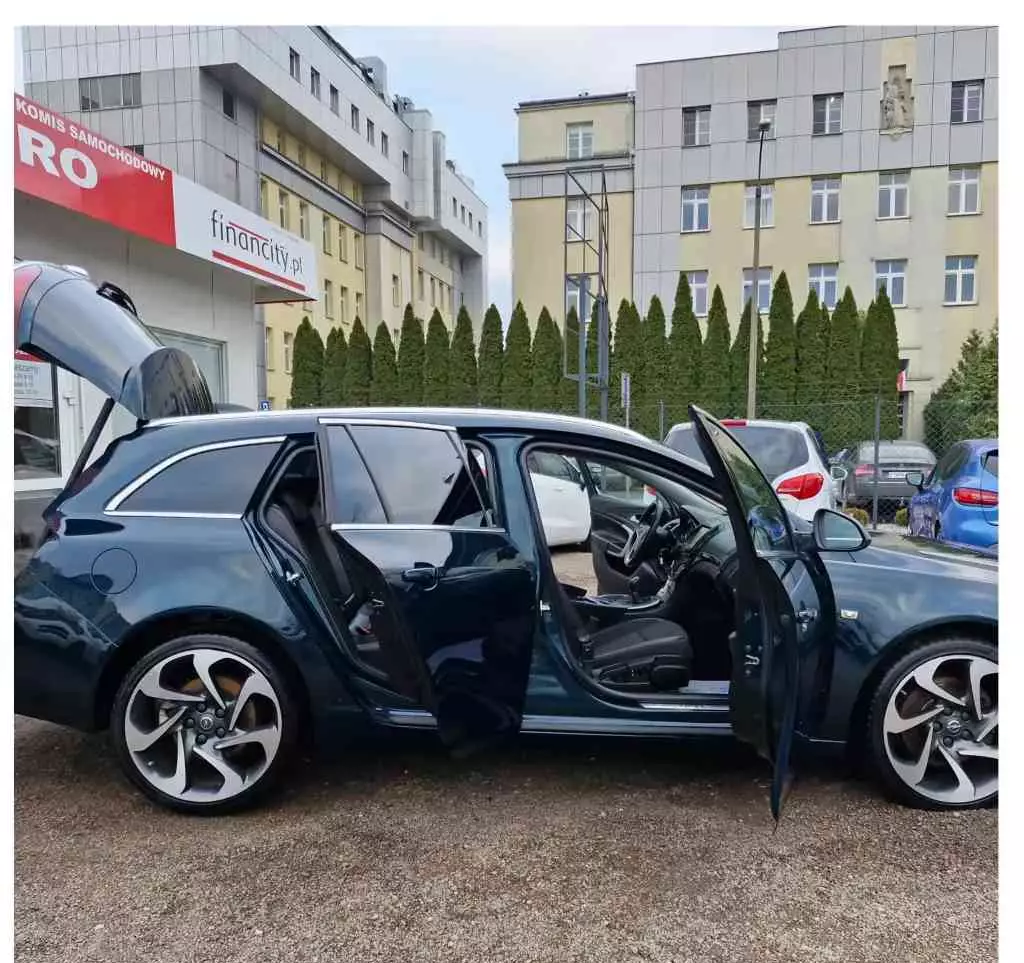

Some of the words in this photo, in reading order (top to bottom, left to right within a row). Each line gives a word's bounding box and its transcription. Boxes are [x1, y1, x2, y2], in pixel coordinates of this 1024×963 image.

[16, 97, 66, 134] KOMIS
[69, 124, 166, 181] SAMOCHODOWY
[17, 122, 98, 189] RO
[211, 208, 304, 276] financity.pl
